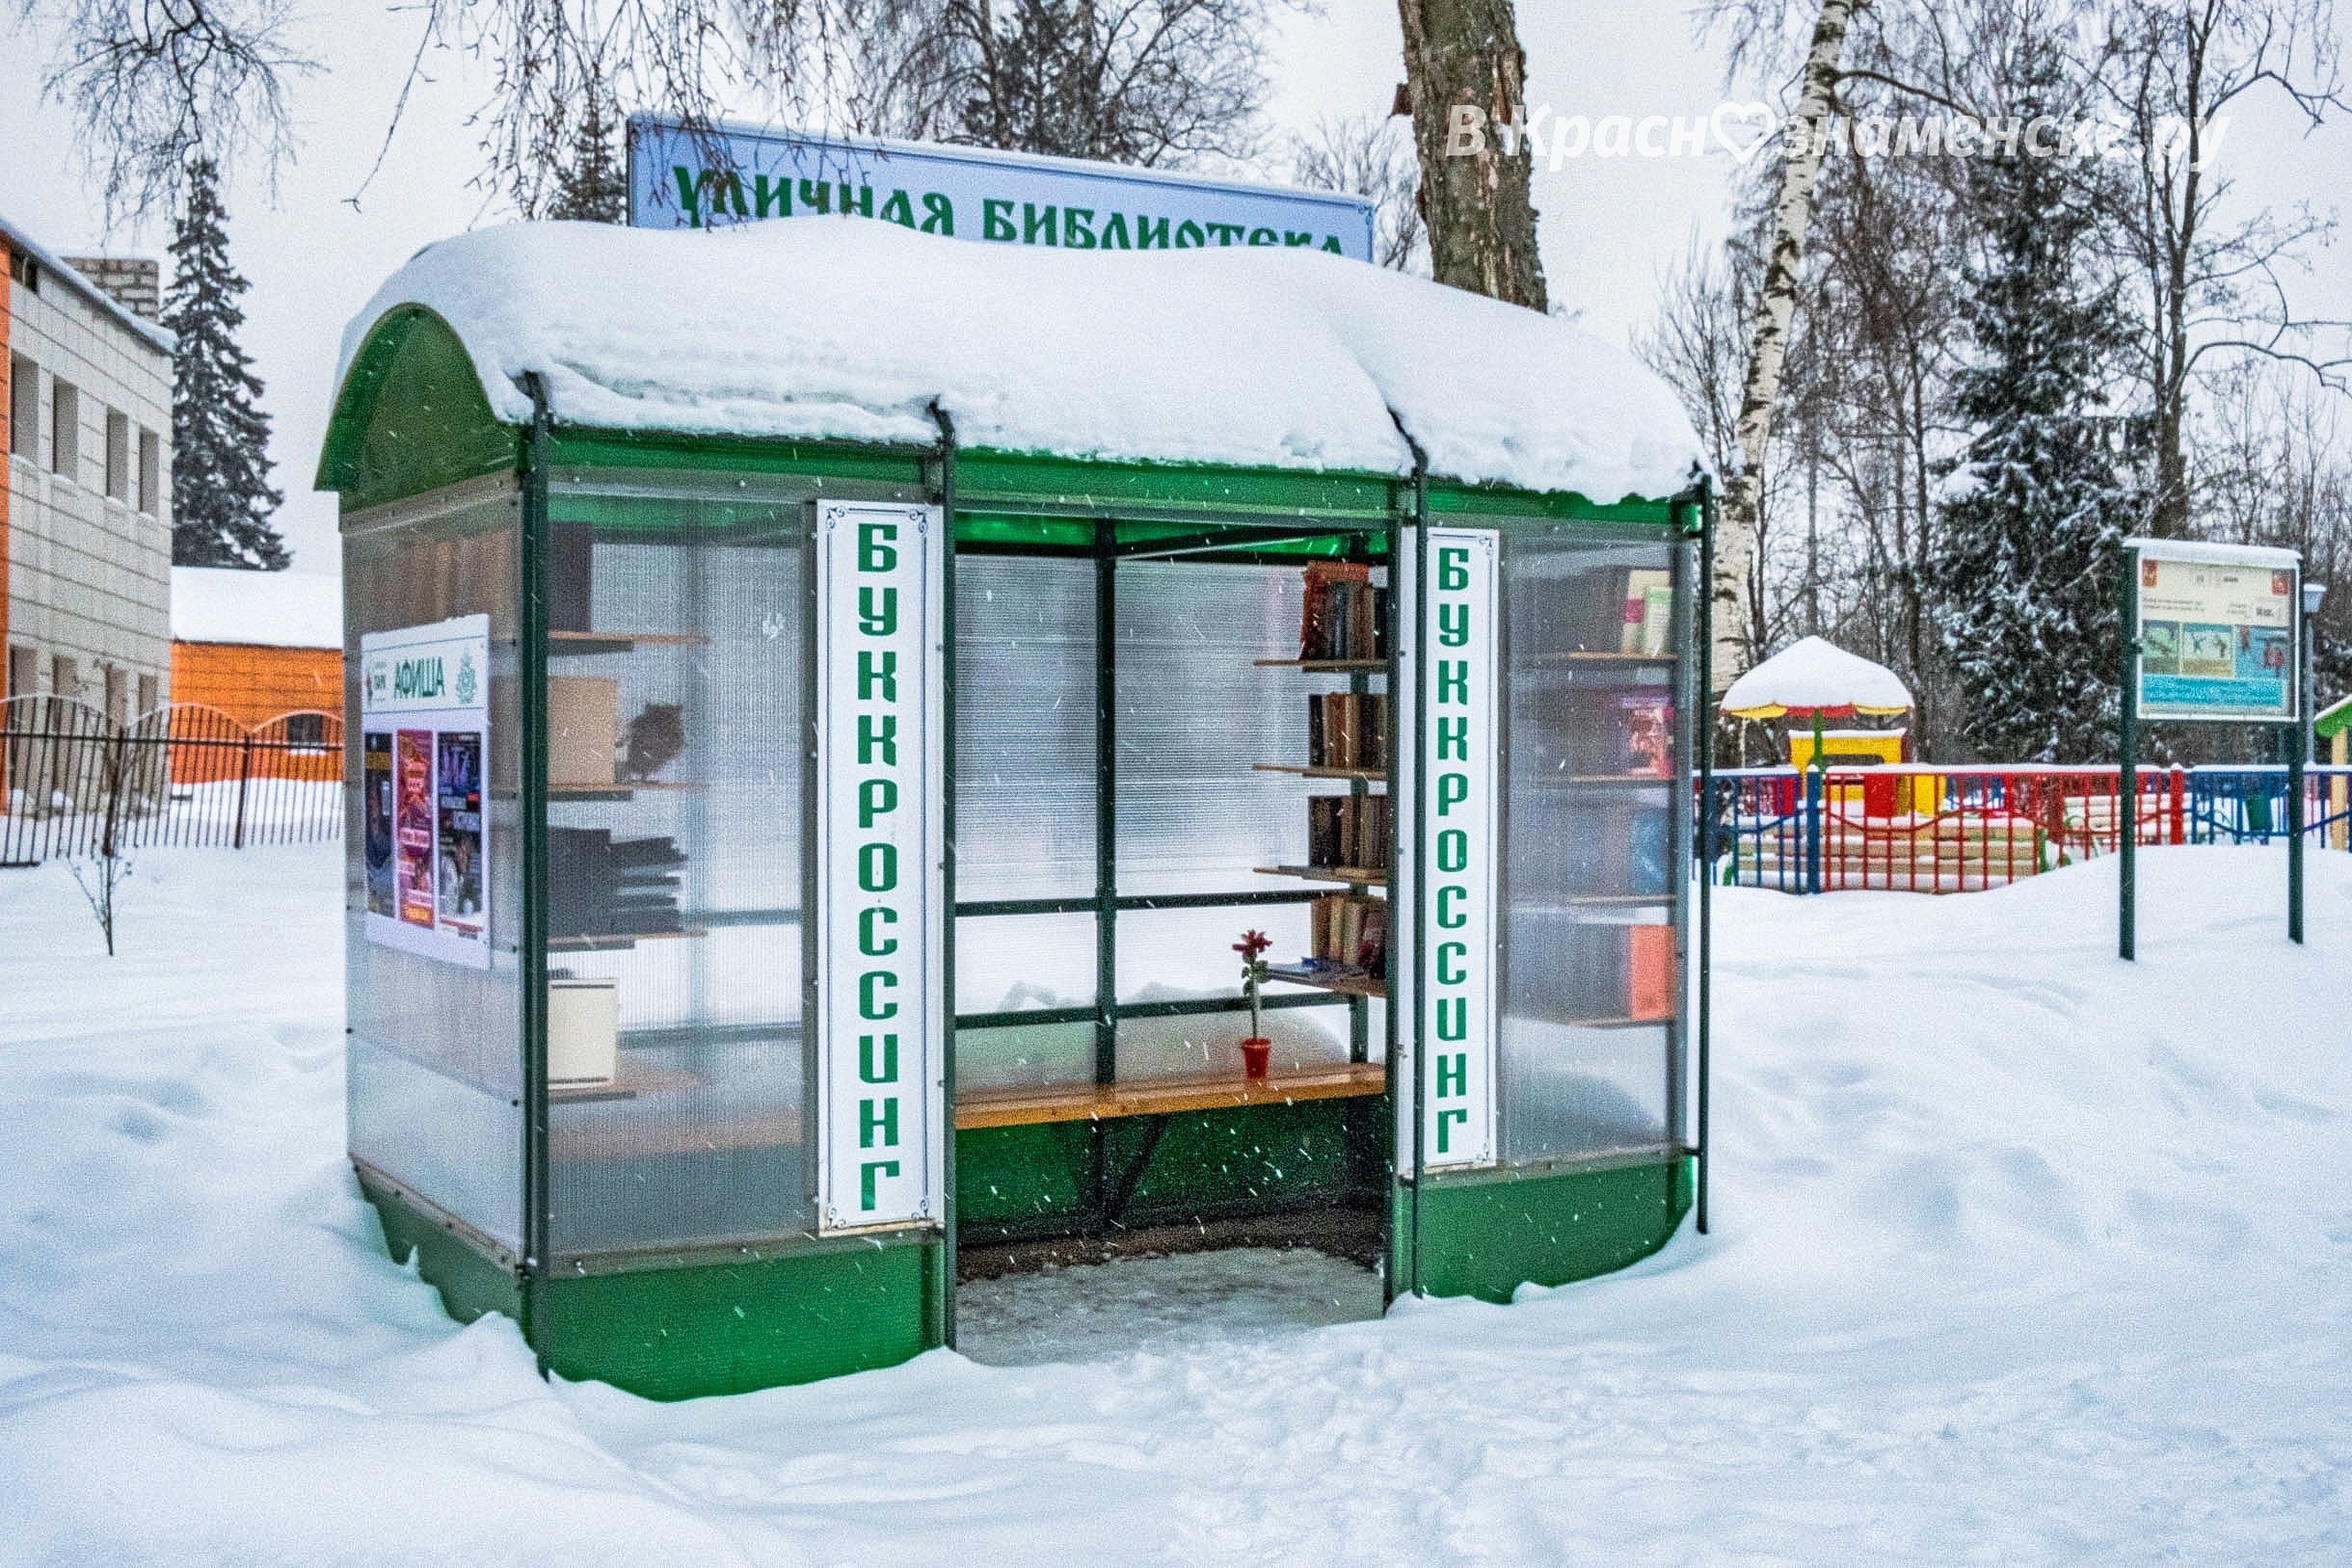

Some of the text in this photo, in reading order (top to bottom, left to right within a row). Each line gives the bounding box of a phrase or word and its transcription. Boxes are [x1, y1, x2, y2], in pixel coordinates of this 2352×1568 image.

[393, 656, 445, 701] АФИША
[857, 522, 900, 1211] БУККРОССИНГ
[1435, 546, 1469, 1154] БУККРОССИНГ
